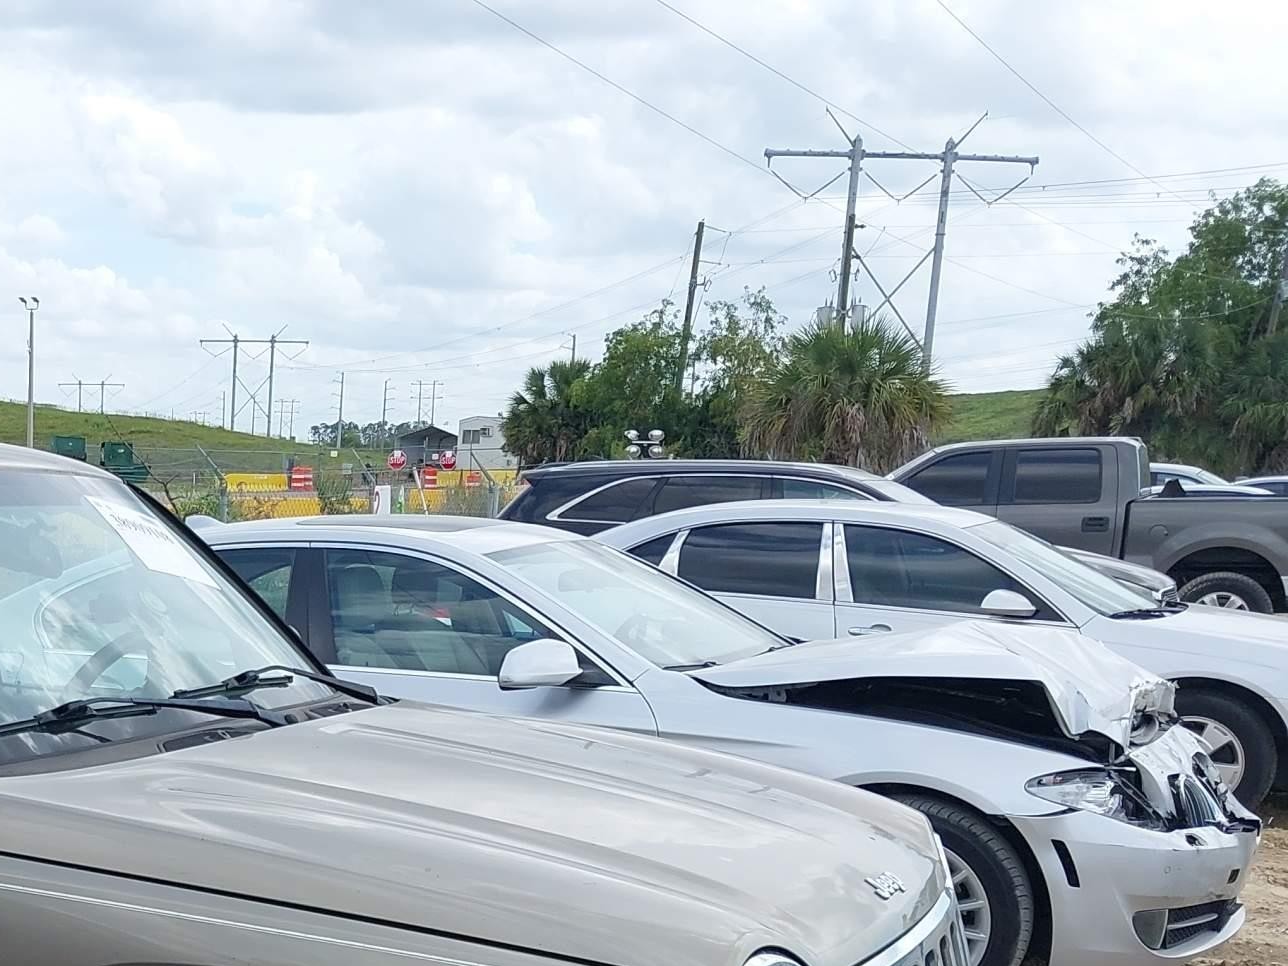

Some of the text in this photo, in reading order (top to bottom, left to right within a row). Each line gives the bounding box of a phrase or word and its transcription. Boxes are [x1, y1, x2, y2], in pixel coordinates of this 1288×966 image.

[390, 456, 405, 464] STOP
[442, 456, 457, 465] STOP
[864, 871, 906, 901] Jeep
